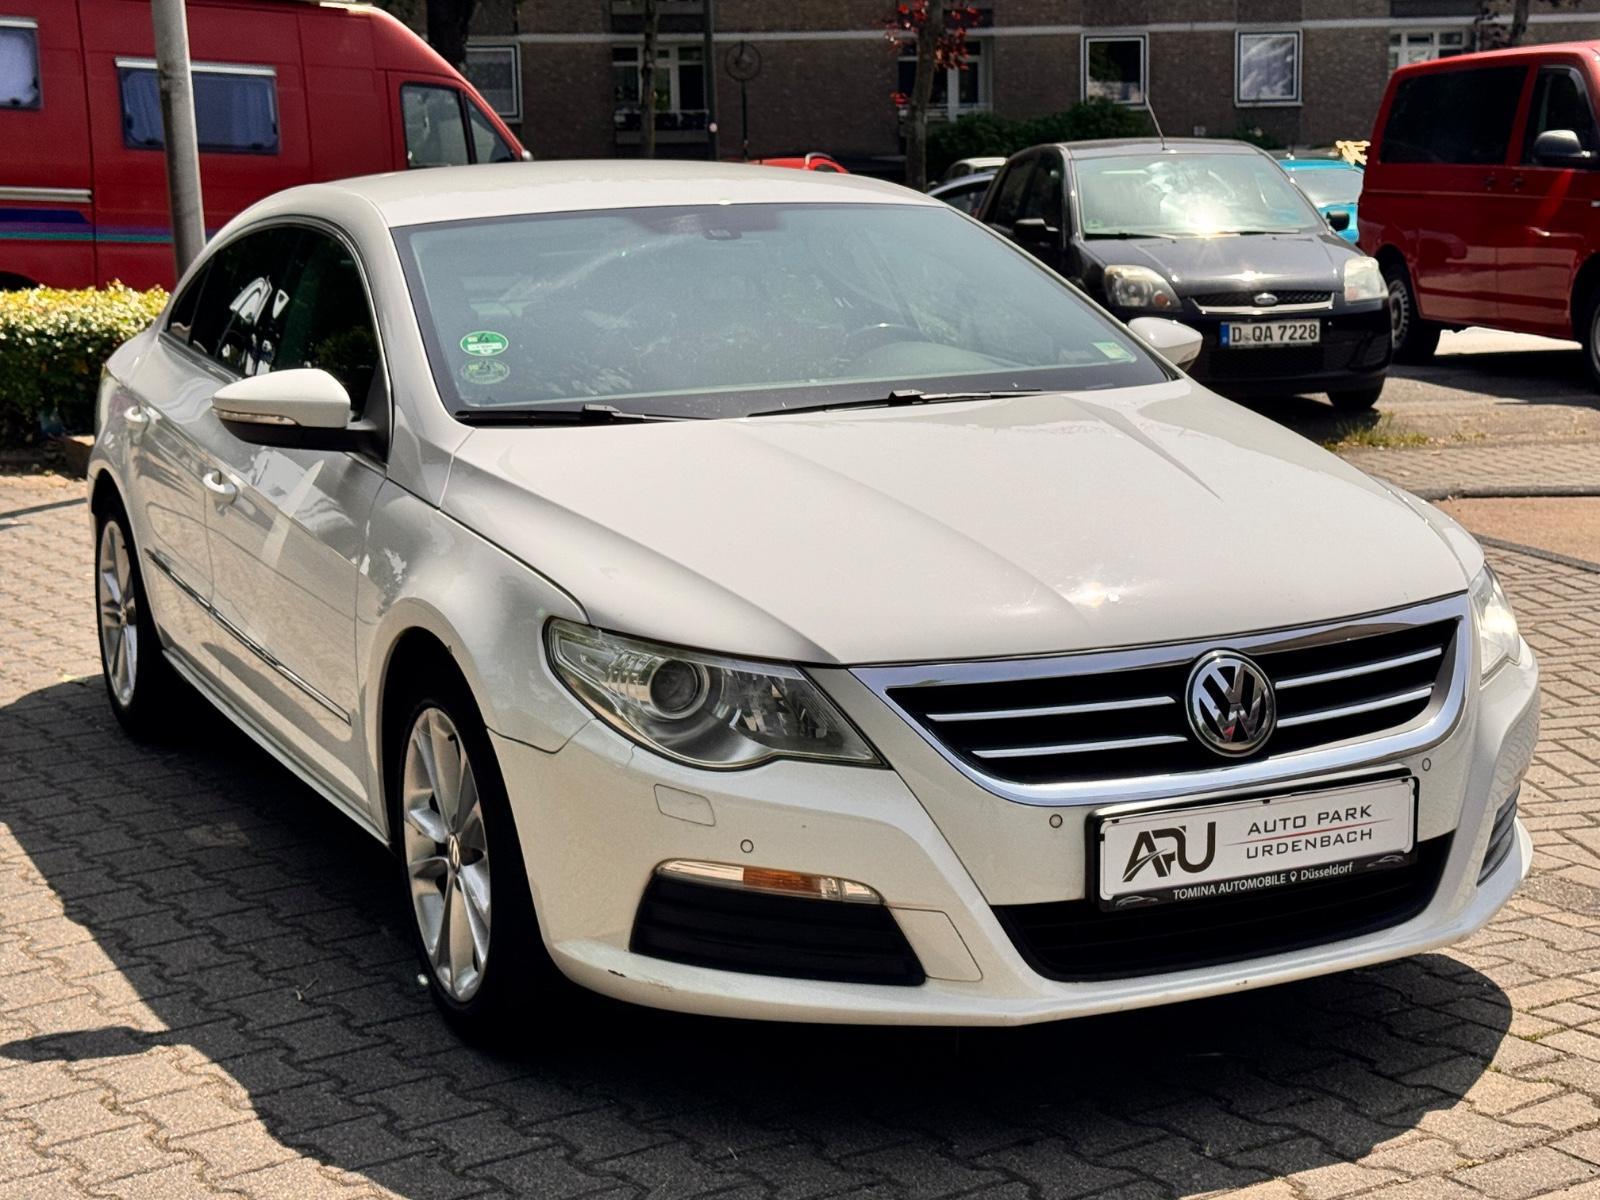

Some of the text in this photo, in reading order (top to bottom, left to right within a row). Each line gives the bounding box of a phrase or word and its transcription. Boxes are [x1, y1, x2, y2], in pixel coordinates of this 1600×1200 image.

[1231, 324, 1317, 342] D QA 7228
[1247, 804, 1373, 836] AUTO PARK
[1246, 828, 1373, 859] URDENBACH
[1172, 862, 1354, 901] TOMINA AUTOMOBILE Düsseldorf
